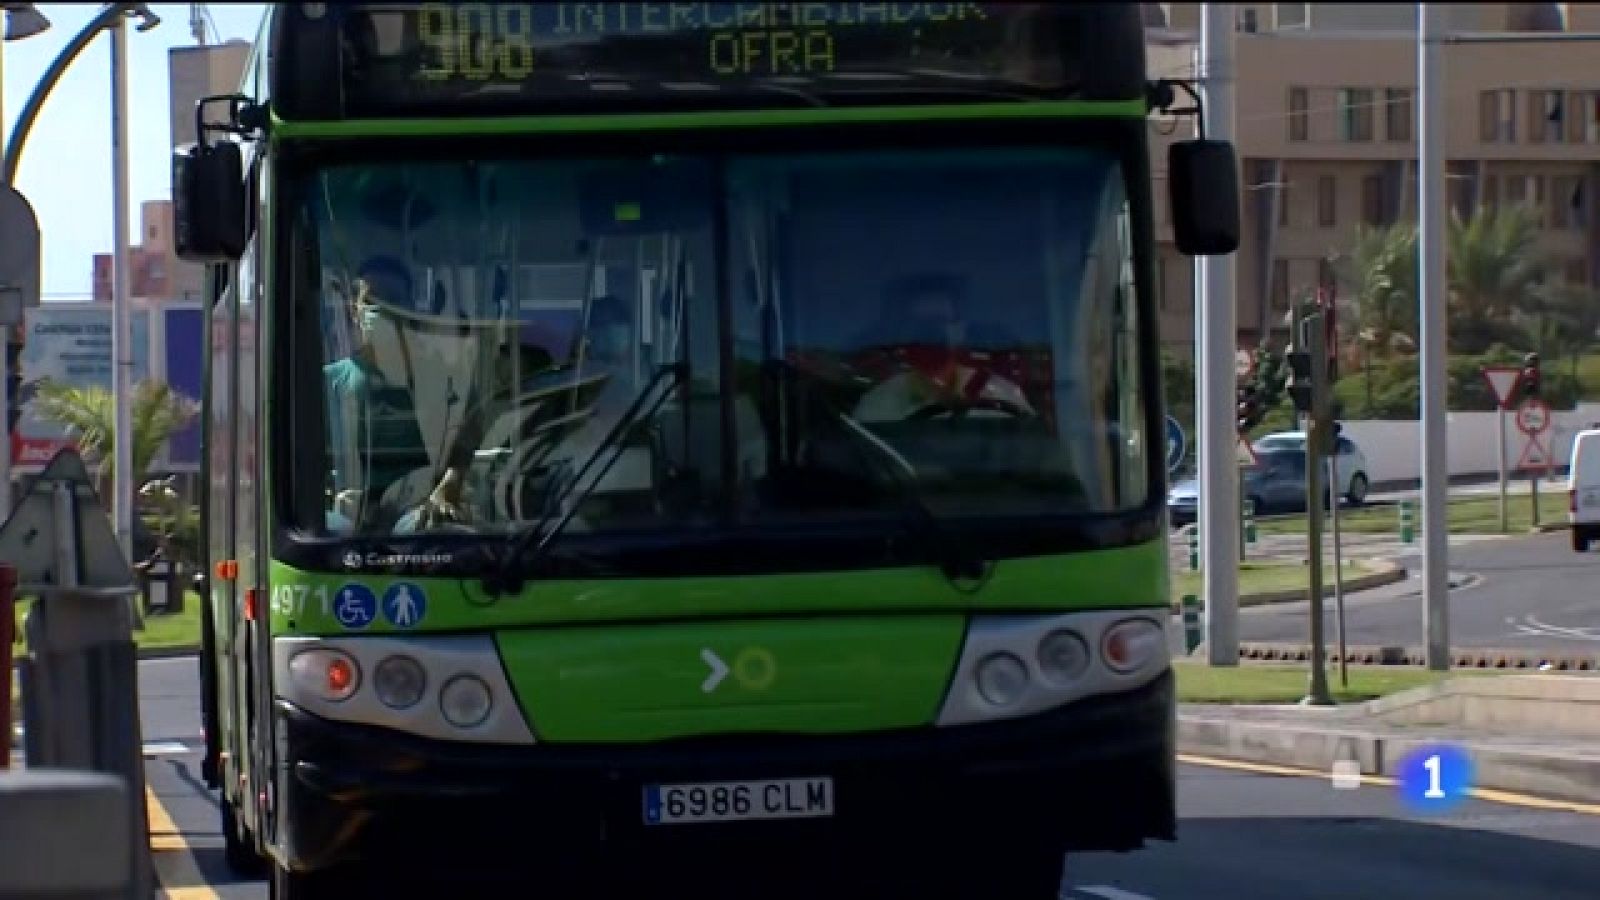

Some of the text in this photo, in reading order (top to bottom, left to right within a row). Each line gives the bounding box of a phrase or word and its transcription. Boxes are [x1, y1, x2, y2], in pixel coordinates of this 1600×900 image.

[552, 2, 988, 33] INTERCAMBIADOR
[418, 4, 533, 80] 908
[709, 31, 834, 74] OFRA
[271, 584, 329, 616] 4971
[666, 781, 826, 817] 6986 CLM
